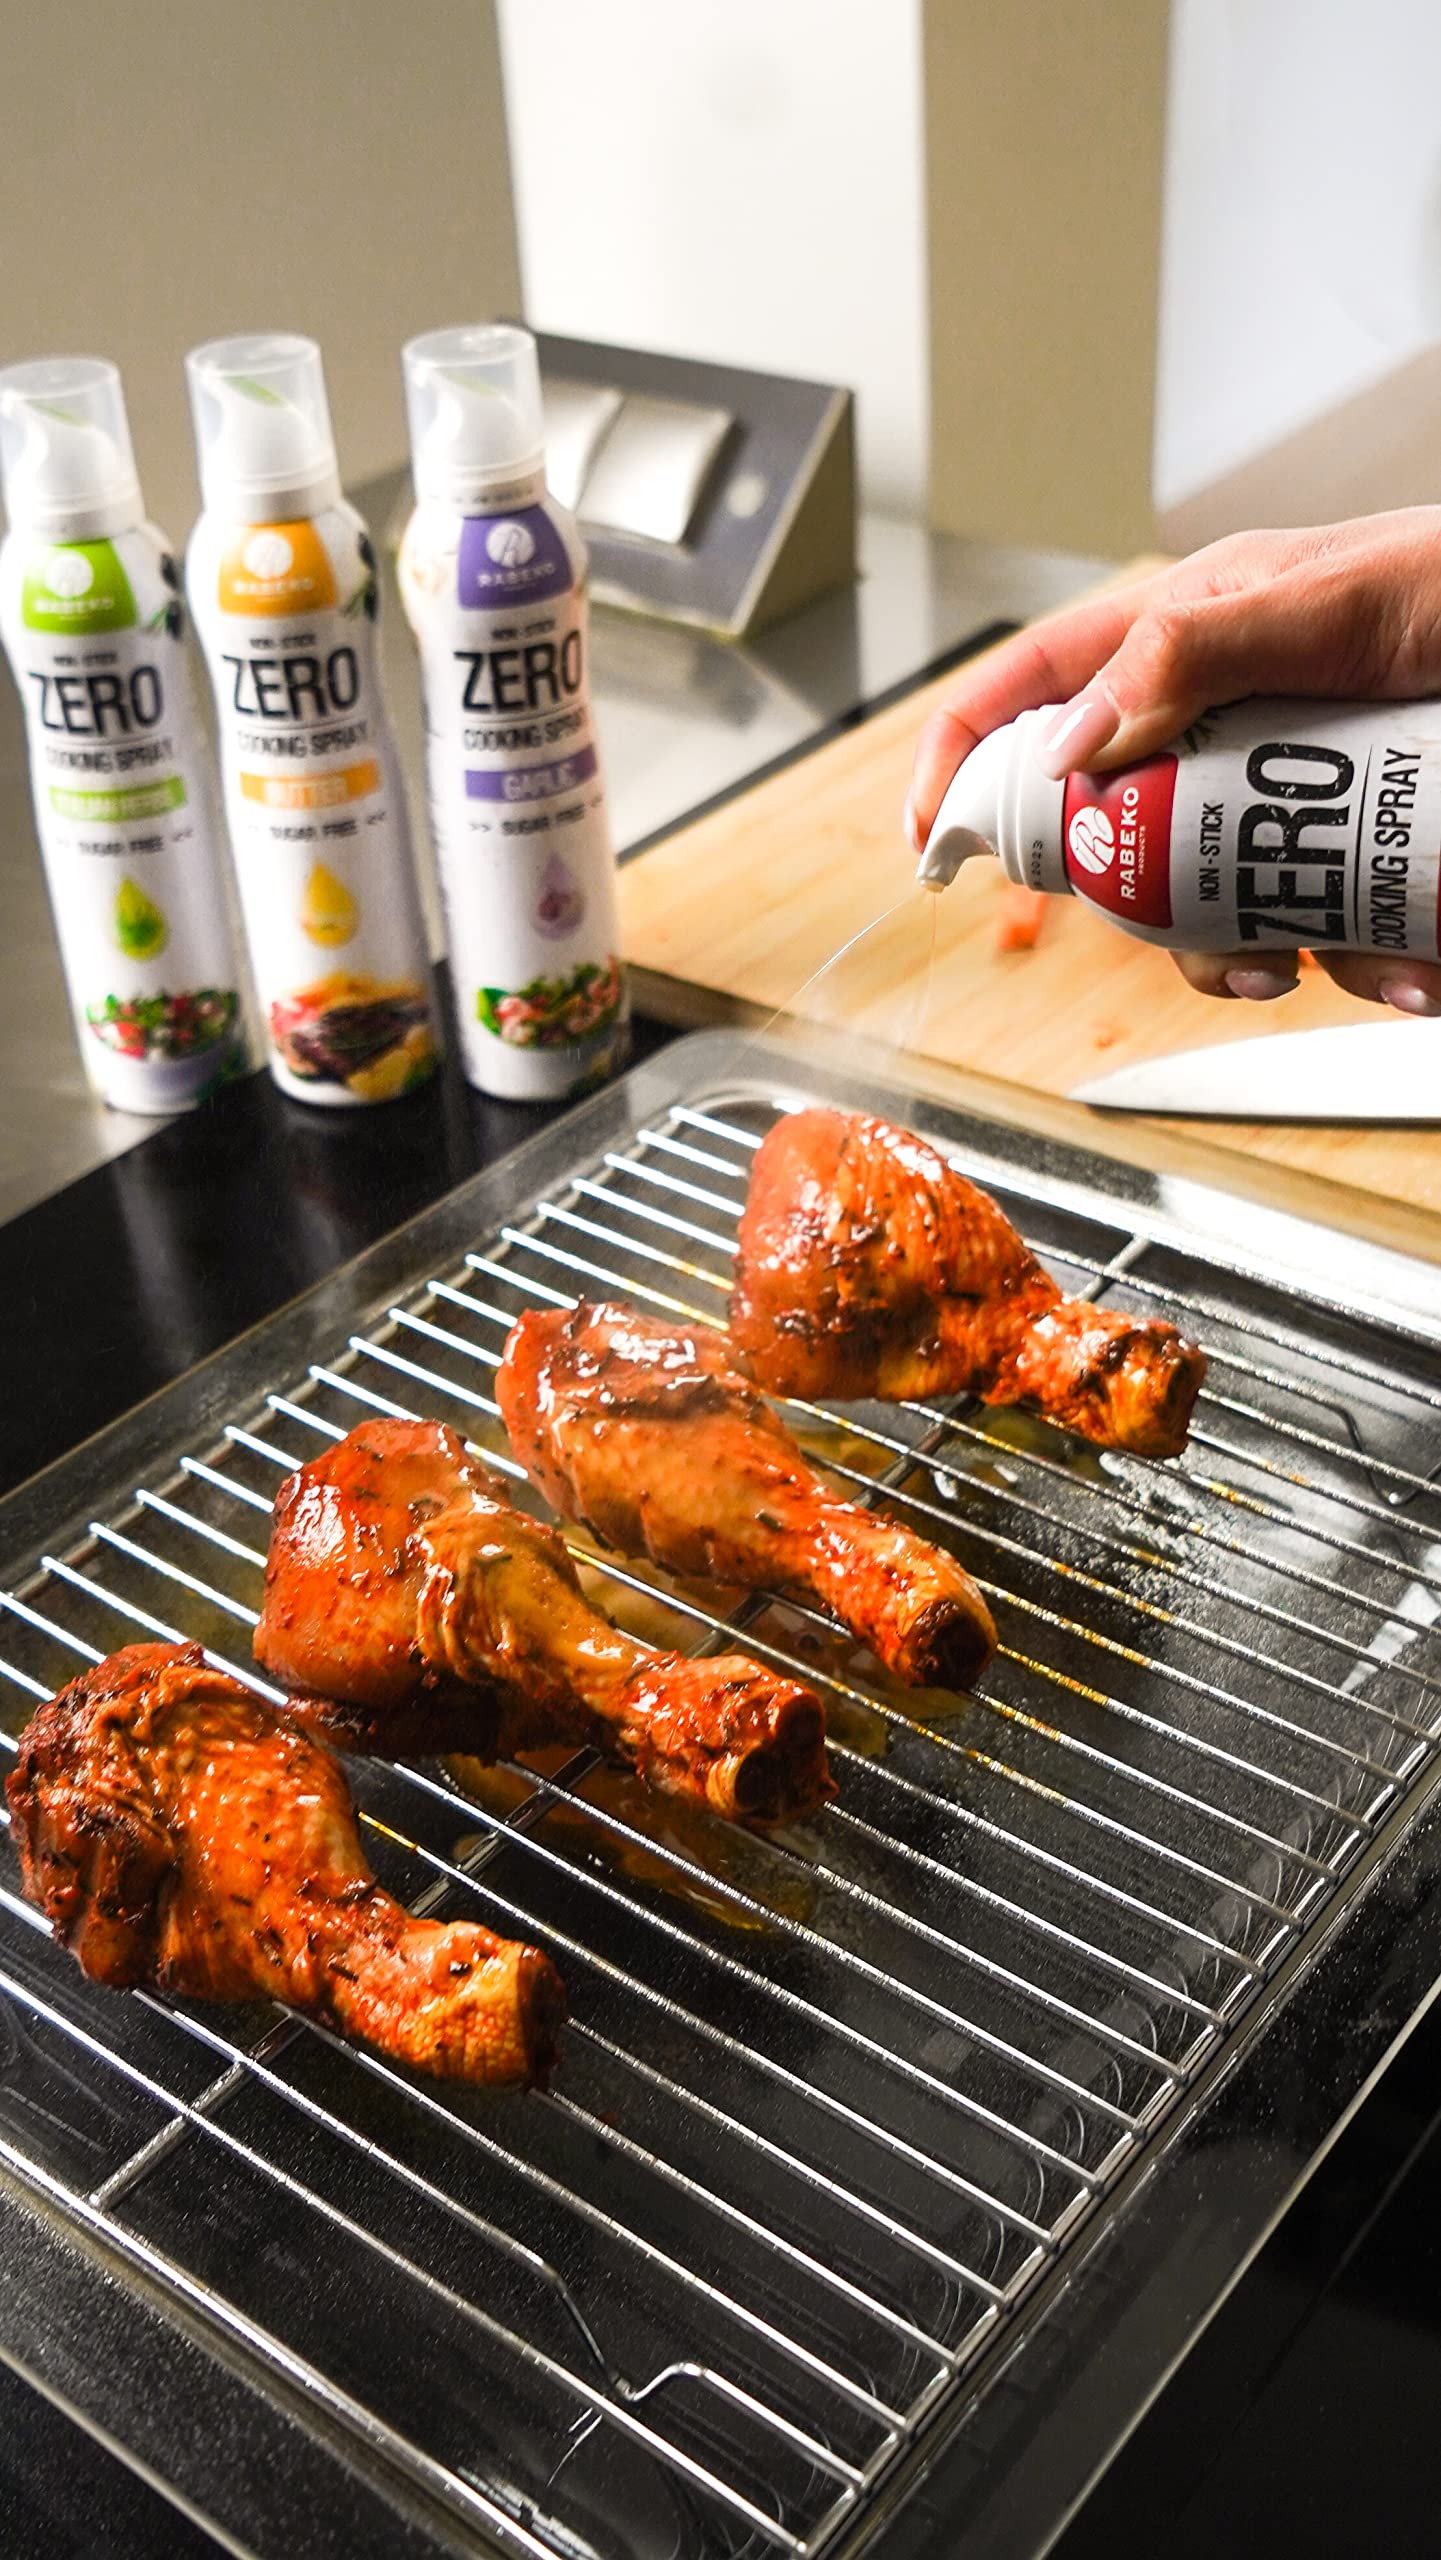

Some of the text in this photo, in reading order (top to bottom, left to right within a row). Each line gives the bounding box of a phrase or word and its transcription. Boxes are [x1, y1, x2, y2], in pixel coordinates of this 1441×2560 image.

[28, 665, 164, 736] ZERO
[222, 646, 359, 721] ZERO
[453, 630, 582, 713] ZERO
[1120, 787, 1139, 900] RABEKO
[1137, 825, 1146, 875] PRODUCTS
[1236, 742, 1355, 942] ZERO
[1370, 748, 1422, 950] COOKING SPRAY
